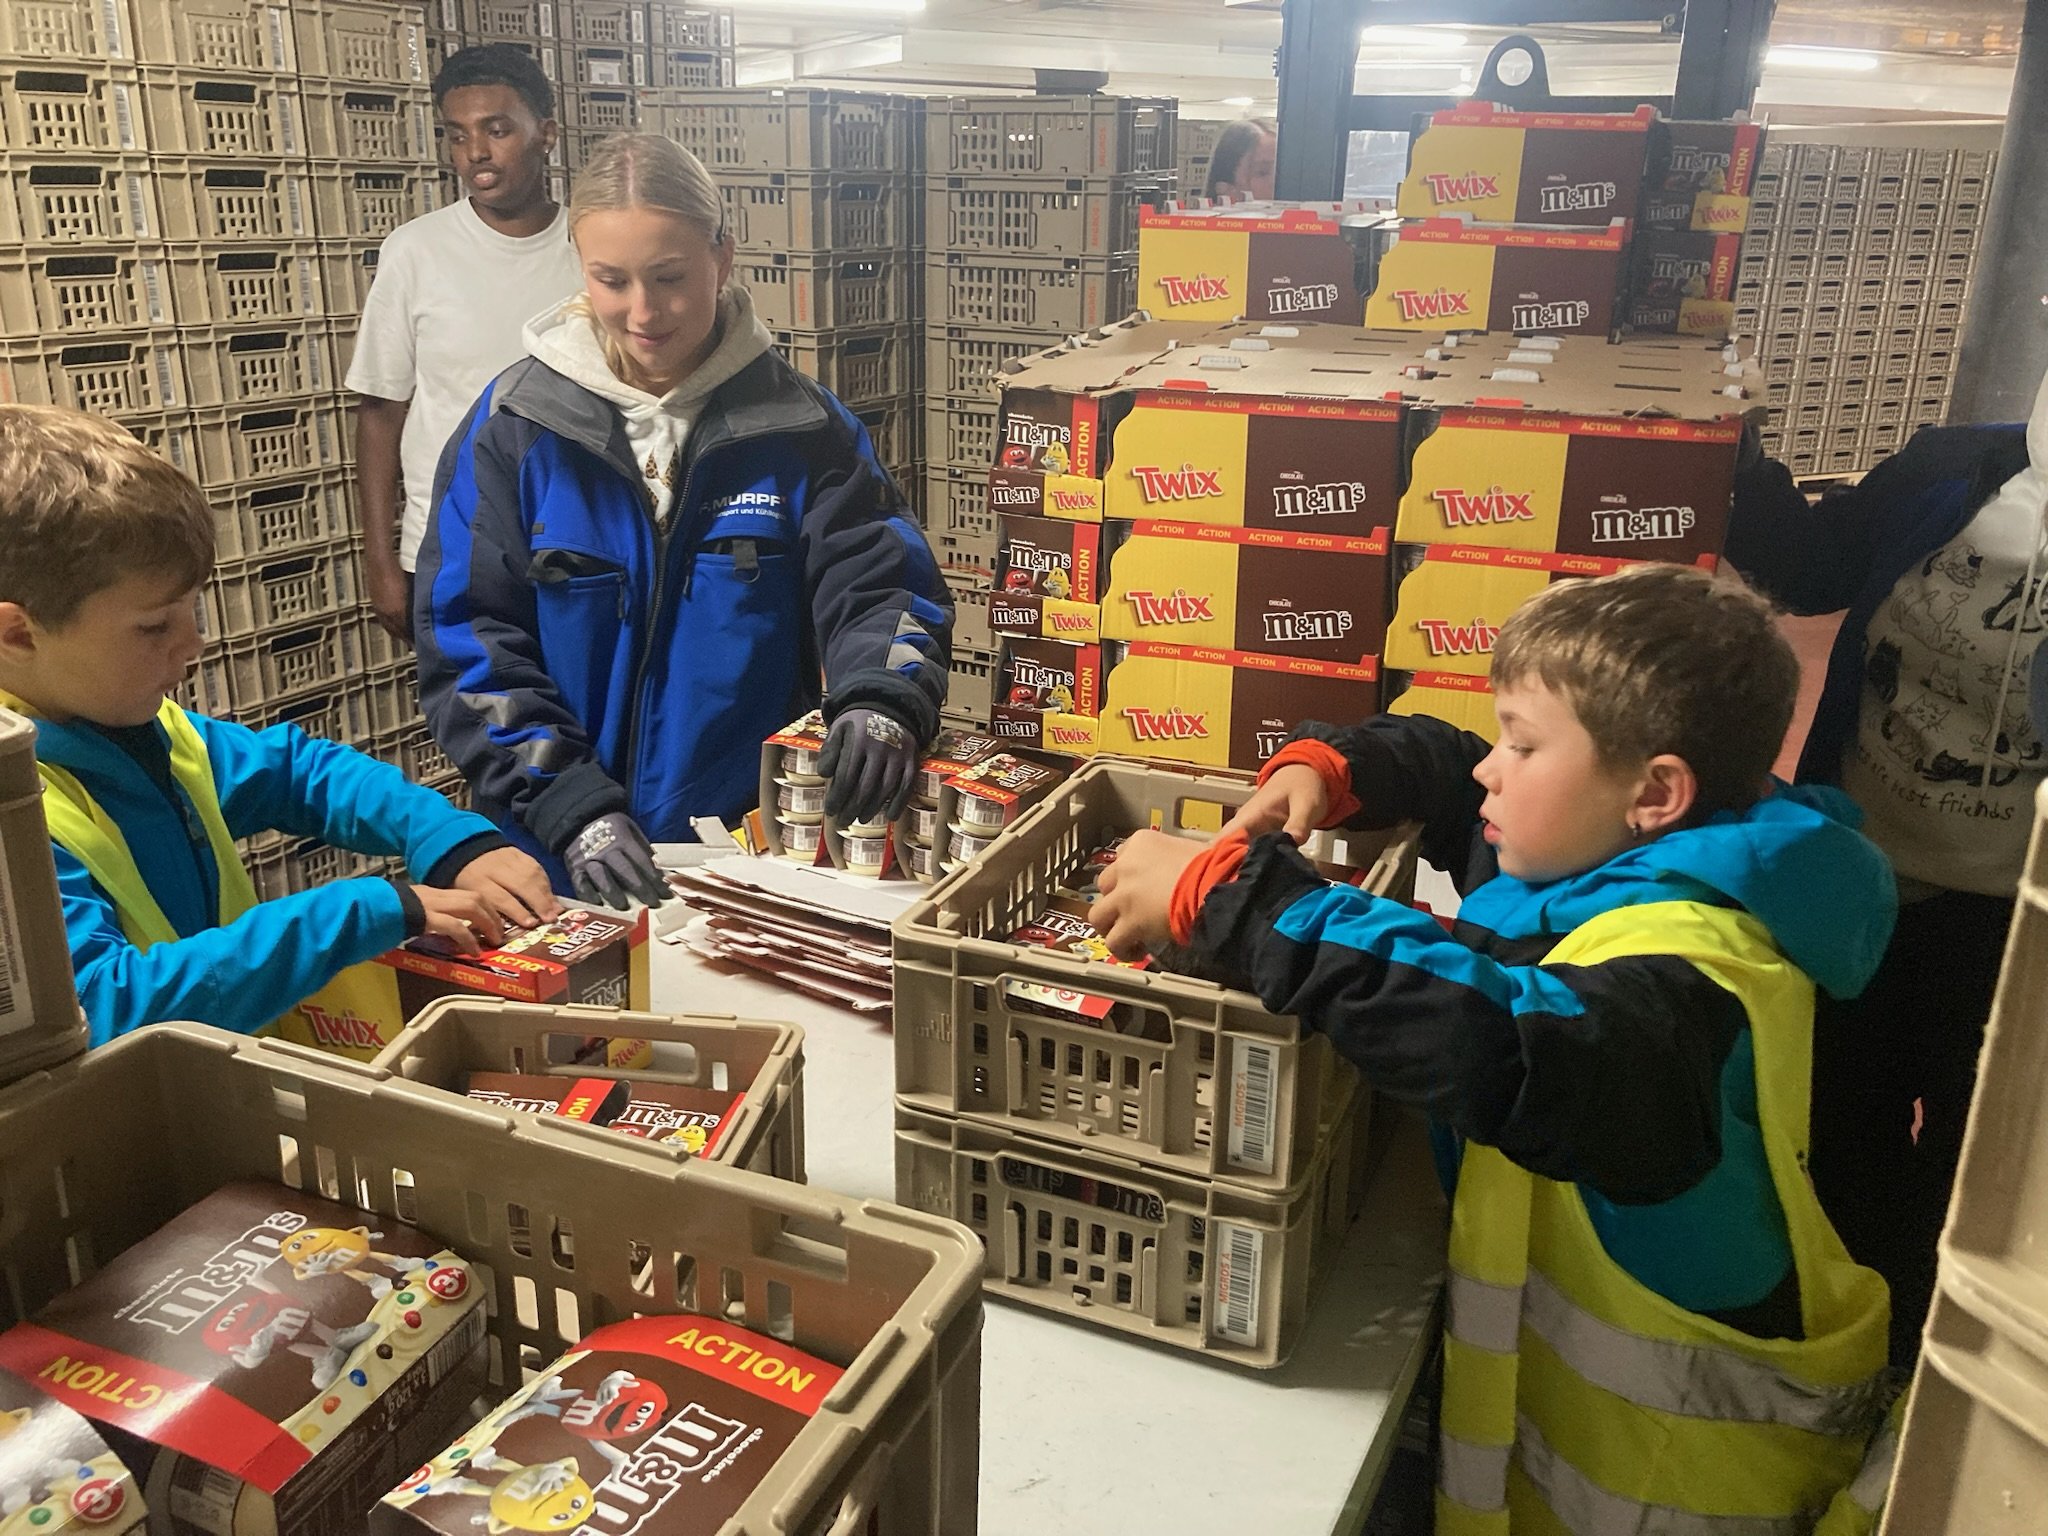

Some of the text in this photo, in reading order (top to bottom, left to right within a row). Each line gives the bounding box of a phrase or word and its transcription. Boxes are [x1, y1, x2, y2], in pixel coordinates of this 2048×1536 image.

[1451, 115, 1481, 123] ACTION
[1490, 116, 1520, 124] ACTION
[1574, 119, 1604, 127] ACTION
[1615, 120, 1646, 129] ACTION
[1426, 171, 1499, 203] Twix
[1731, 147, 1750, 196] ACTION
[1144, 218, 1322, 232] ACTION ACTION ACTION ACTION ACTION
[1420, 231, 1618, 248] ACTION ACTION ACTION ACTION ACTION
[1160, 273, 1230, 306] Twix
[1395, 287, 1472, 321] Twix
[1157, 396, 1397, 419] ACTION ACTION ACTION ACTION ACTION
[1466, 415, 1735, 439] ACTION ACTION ACTION ACTION ACTION
[1077, 421, 1091, 477] ACTION
[1133, 463, 1224, 503] Twix
[1052, 490, 1097, 510] Twix
[1434, 485, 1536, 527] Twix
[1151, 525, 1382, 551] ACTION ACTION ACTION ACTION ACTION
[1078, 549, 1091, 602] ACTION
[1451, 550, 1601, 571] ACTION ACTION ACTION
[1050, 612, 1095, 631] Twix
[1127, 589, 1214, 626] Twix
[1148, 646, 1372, 678] ACTION ACTION ACTION ACTION ACTION
[1081, 667, 1093, 716] ACTION
[1434, 676, 1471, 686] ACTION
[1050, 727, 1093, 744] Twix
[1124, 705, 1209, 741] Twix
[774, 736, 821, 749] ACTIO
[929, 762, 965, 773] TION
[955, 780, 1009, 800] ACTION
[1937, 792, 2015, 820] friends
[403, 958, 536, 997] ACTION ACTION ACTION
[302, 1003, 387, 1048] Twix
[1219, 1263, 1231, 1304] MIGROS
[666, 1328, 817, 1394] ACTION
[701, 1427, 764, 1484] chocolate
